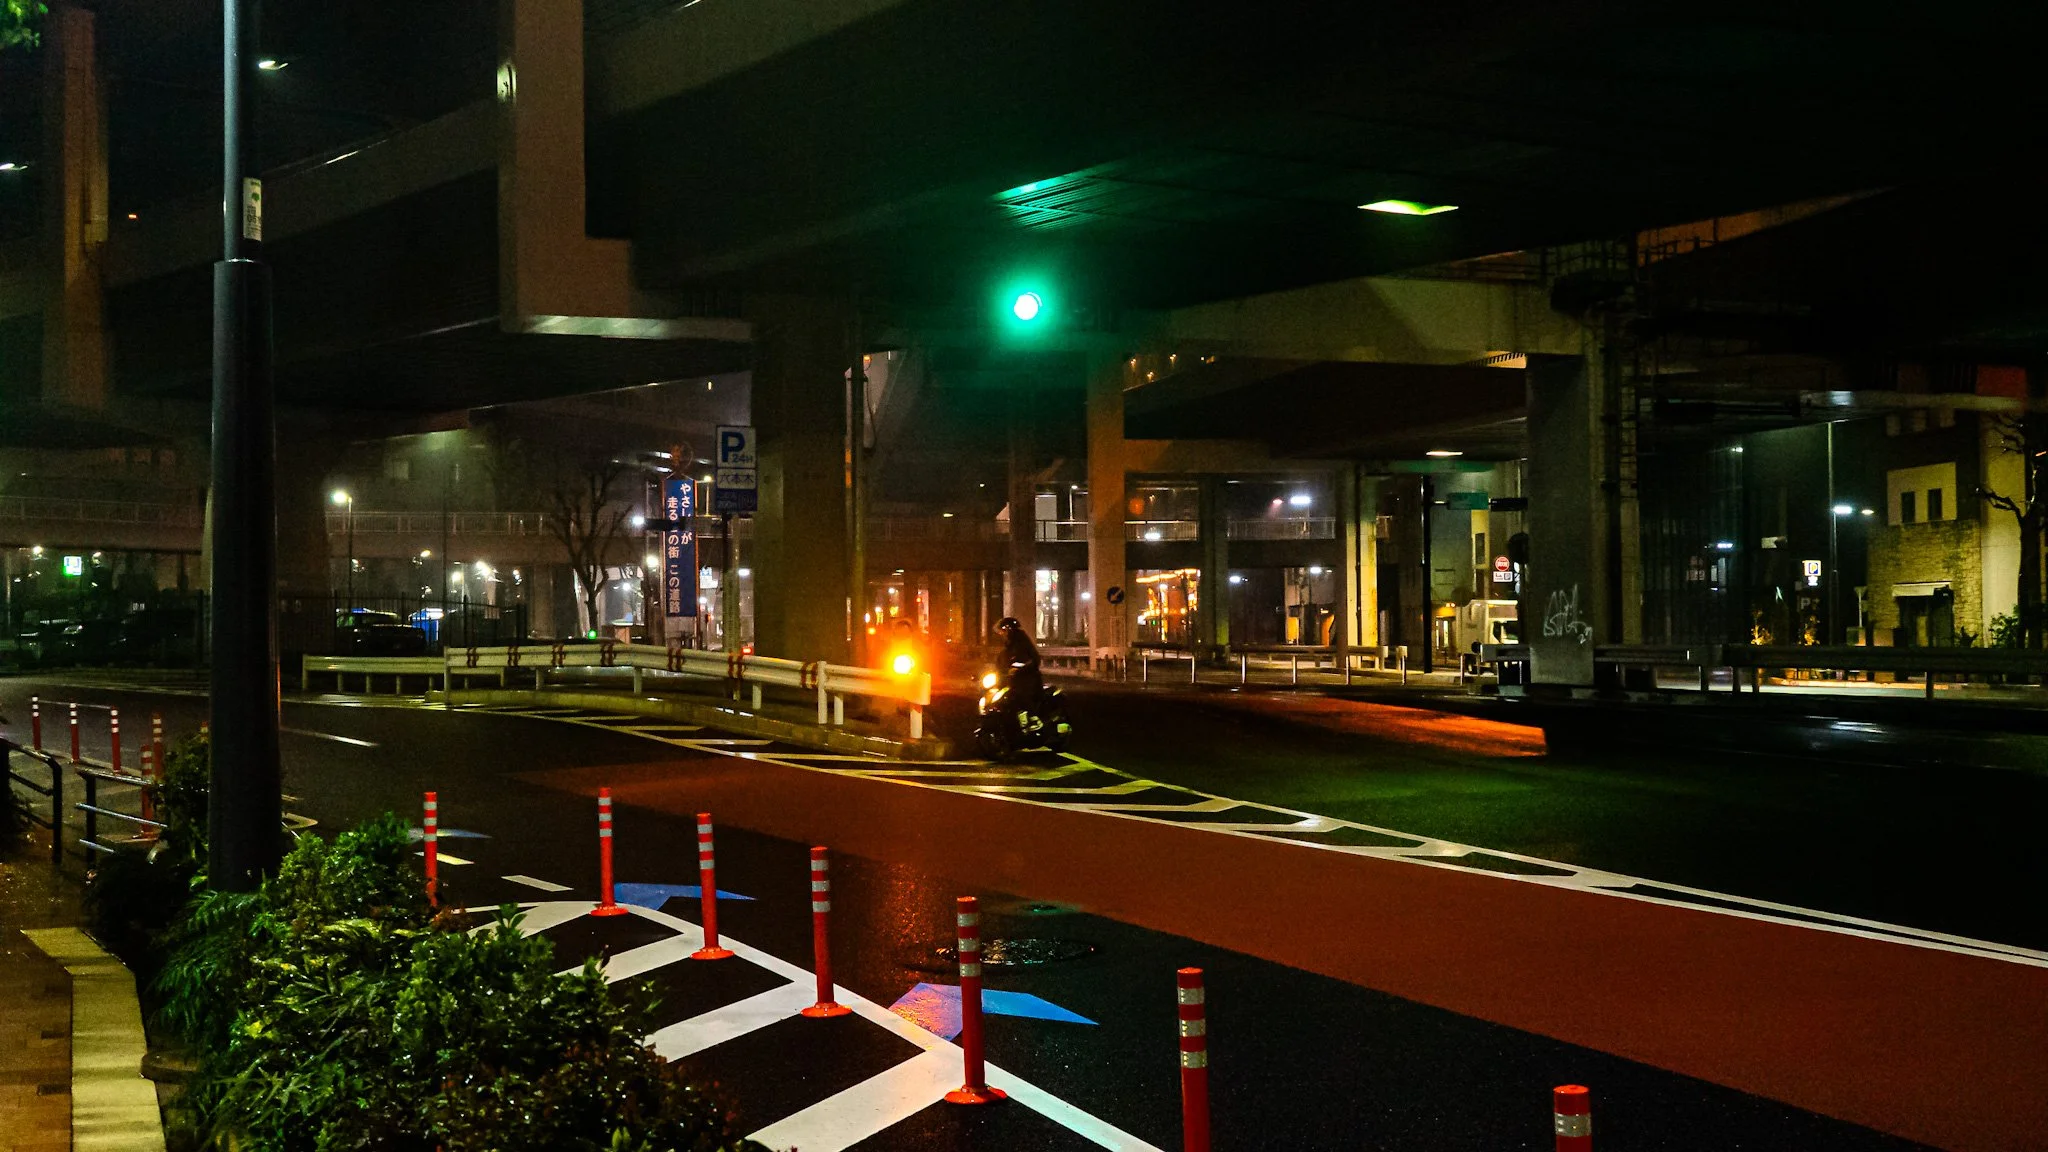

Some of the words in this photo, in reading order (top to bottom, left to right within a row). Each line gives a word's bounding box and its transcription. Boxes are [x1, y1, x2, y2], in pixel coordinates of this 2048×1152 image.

[721, 431, 746, 463] P
[719, 472, 755, 485] 六本木
